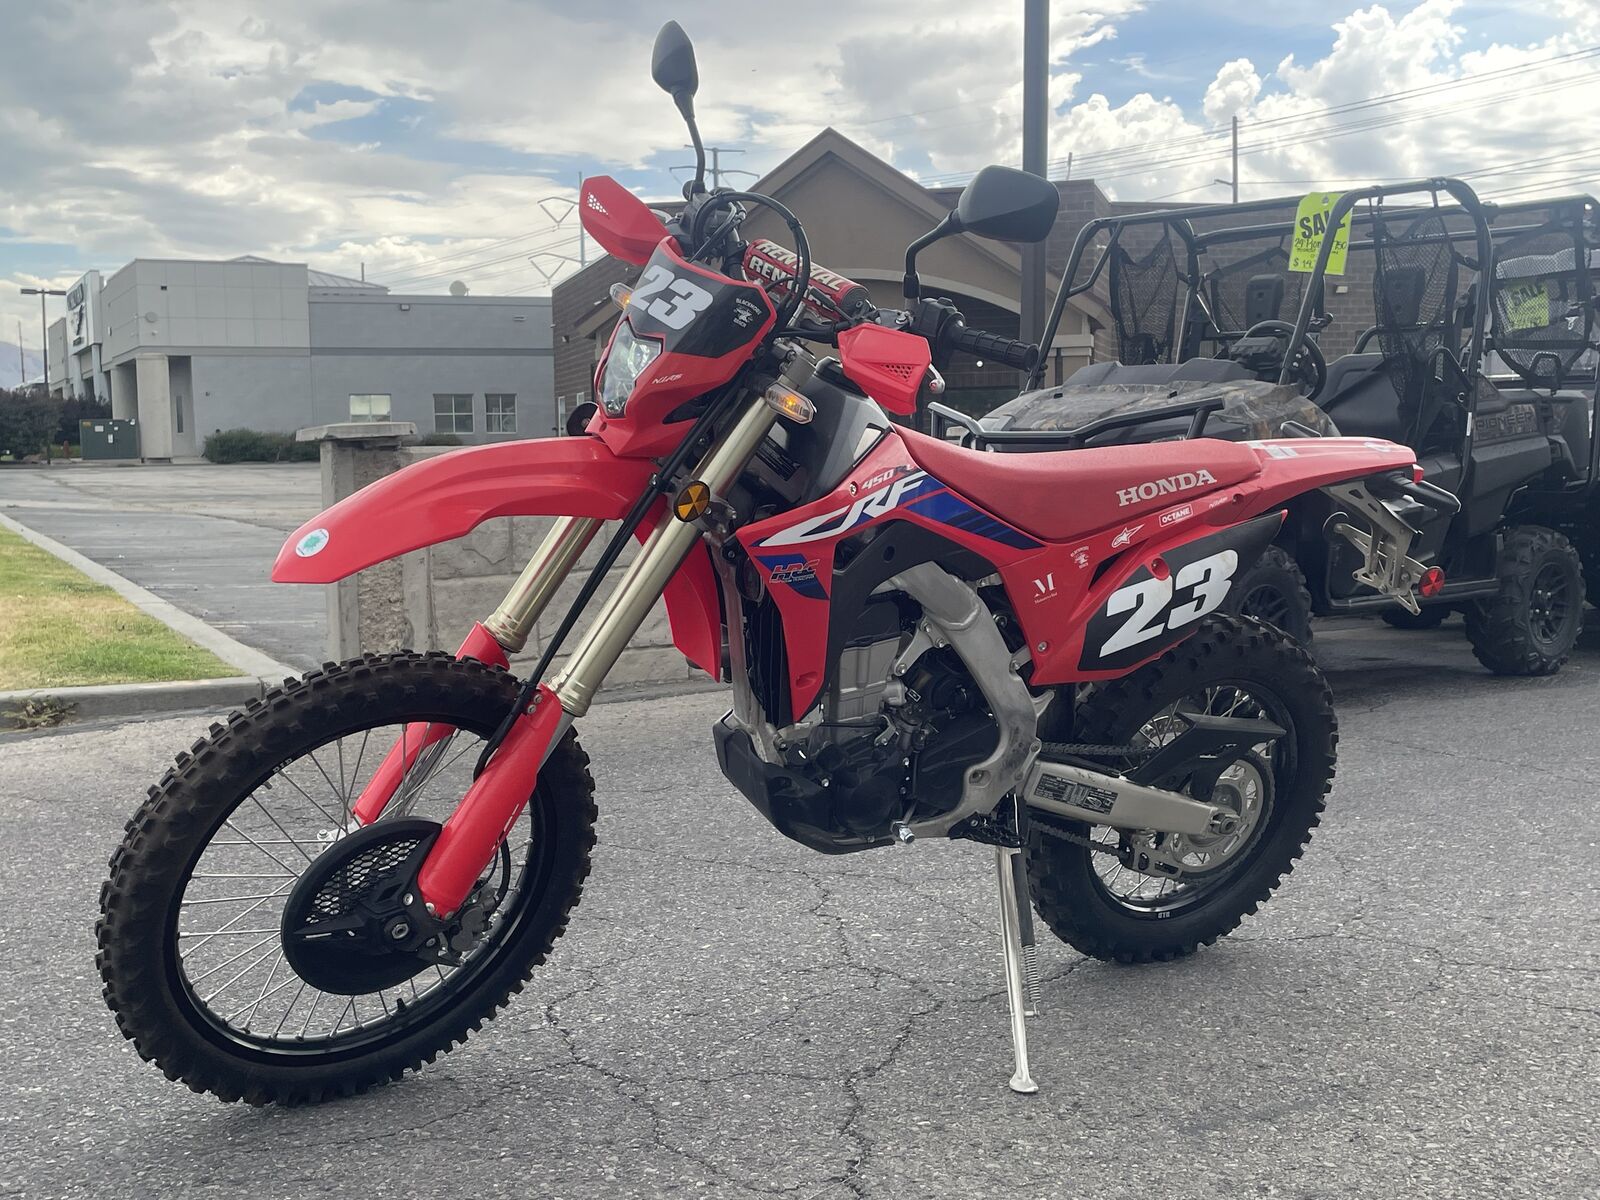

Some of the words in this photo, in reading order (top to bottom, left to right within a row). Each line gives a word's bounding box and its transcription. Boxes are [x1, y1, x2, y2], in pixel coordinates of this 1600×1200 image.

[1300, 210, 1345, 239] SA
[629, 265, 713, 329] 23
[1476, 412, 1534, 430] PIONEER
[1115, 469, 1217, 507] HONDA
[758, 470, 928, 547] CRF
[1161, 506, 1191, 523] OCTANE
[769, 559, 820, 582] HRC
[1099, 549, 1238, 657] 23
